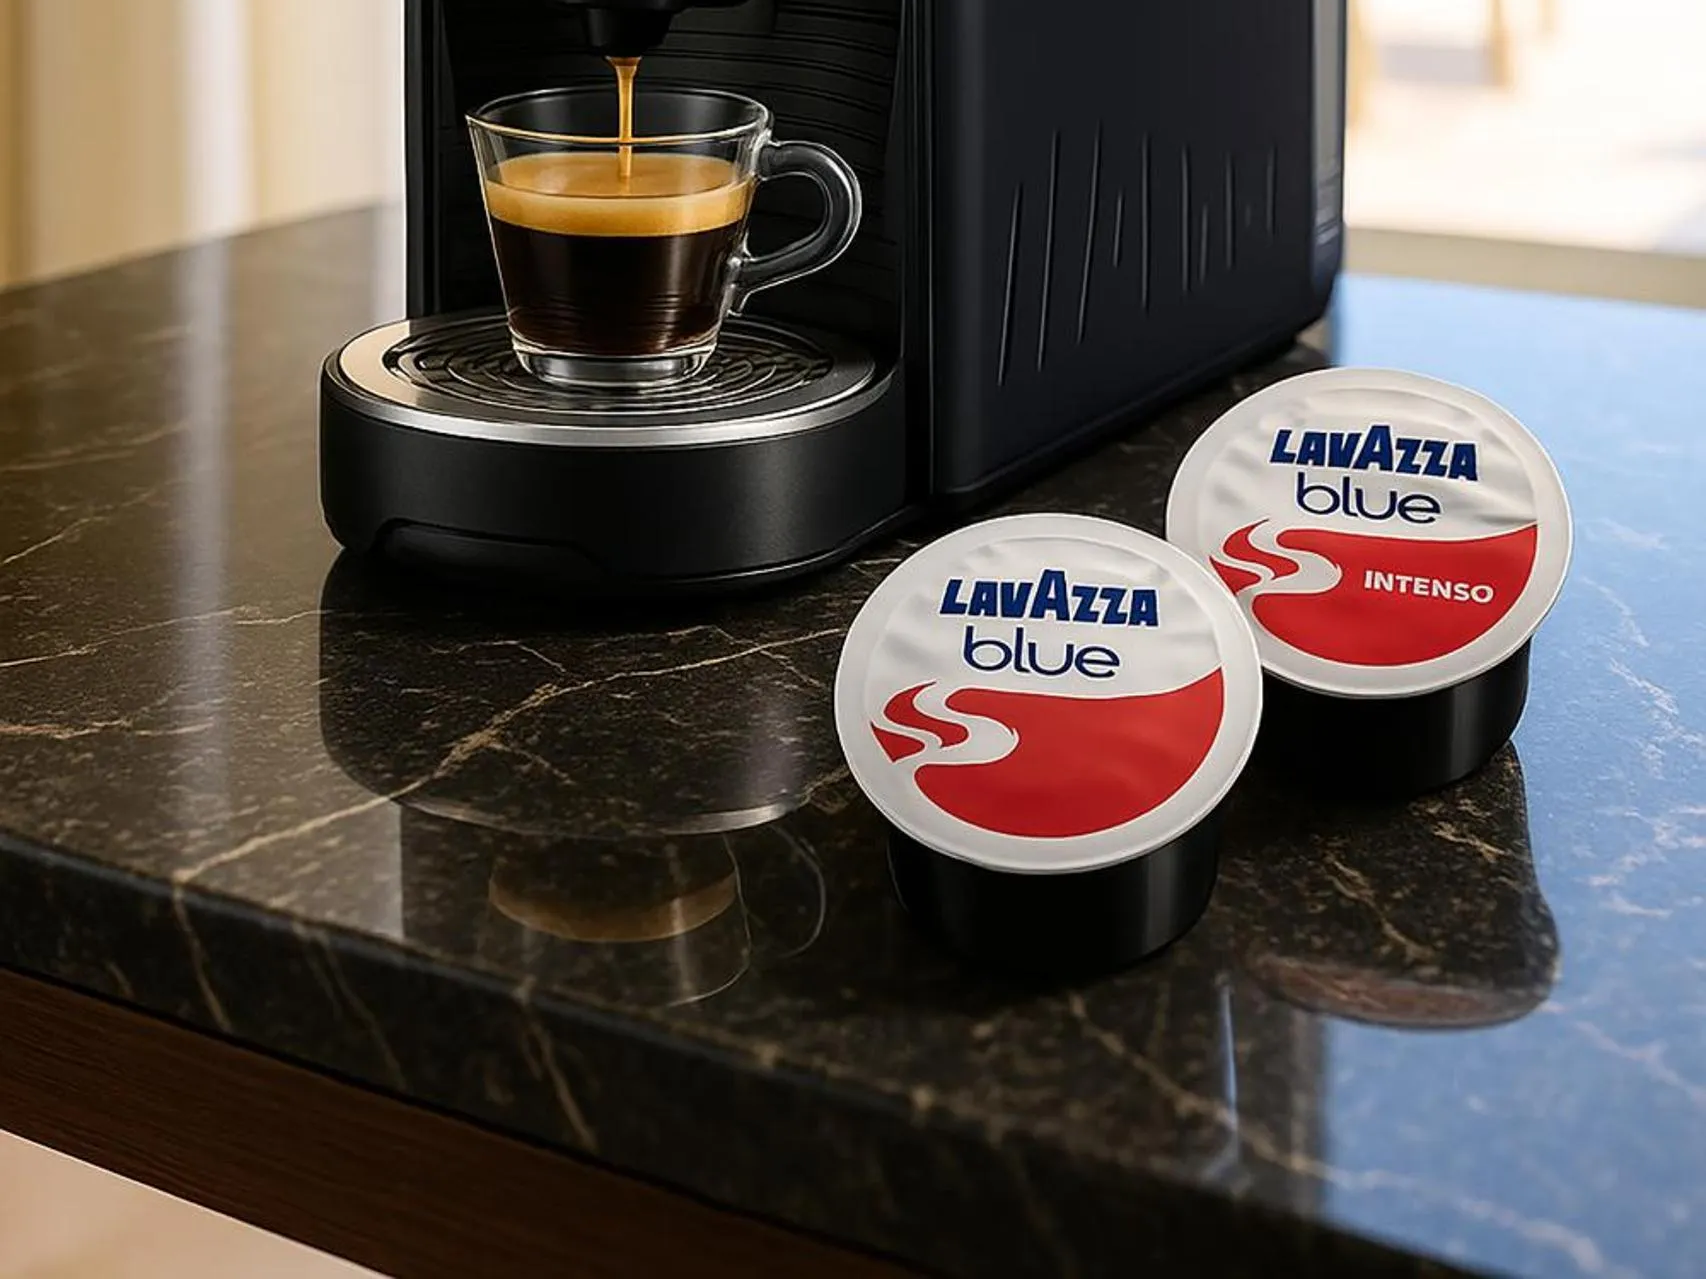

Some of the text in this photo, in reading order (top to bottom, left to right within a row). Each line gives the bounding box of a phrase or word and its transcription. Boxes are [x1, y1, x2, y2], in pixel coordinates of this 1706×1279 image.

[1270, 425, 1478, 482] LAVAZZA
[1297, 472, 1441, 524] blue
[940, 569, 1159, 627] LAVAZZA
[1364, 570, 1494, 603] INTENSO
[964, 625, 1120, 678] blue
